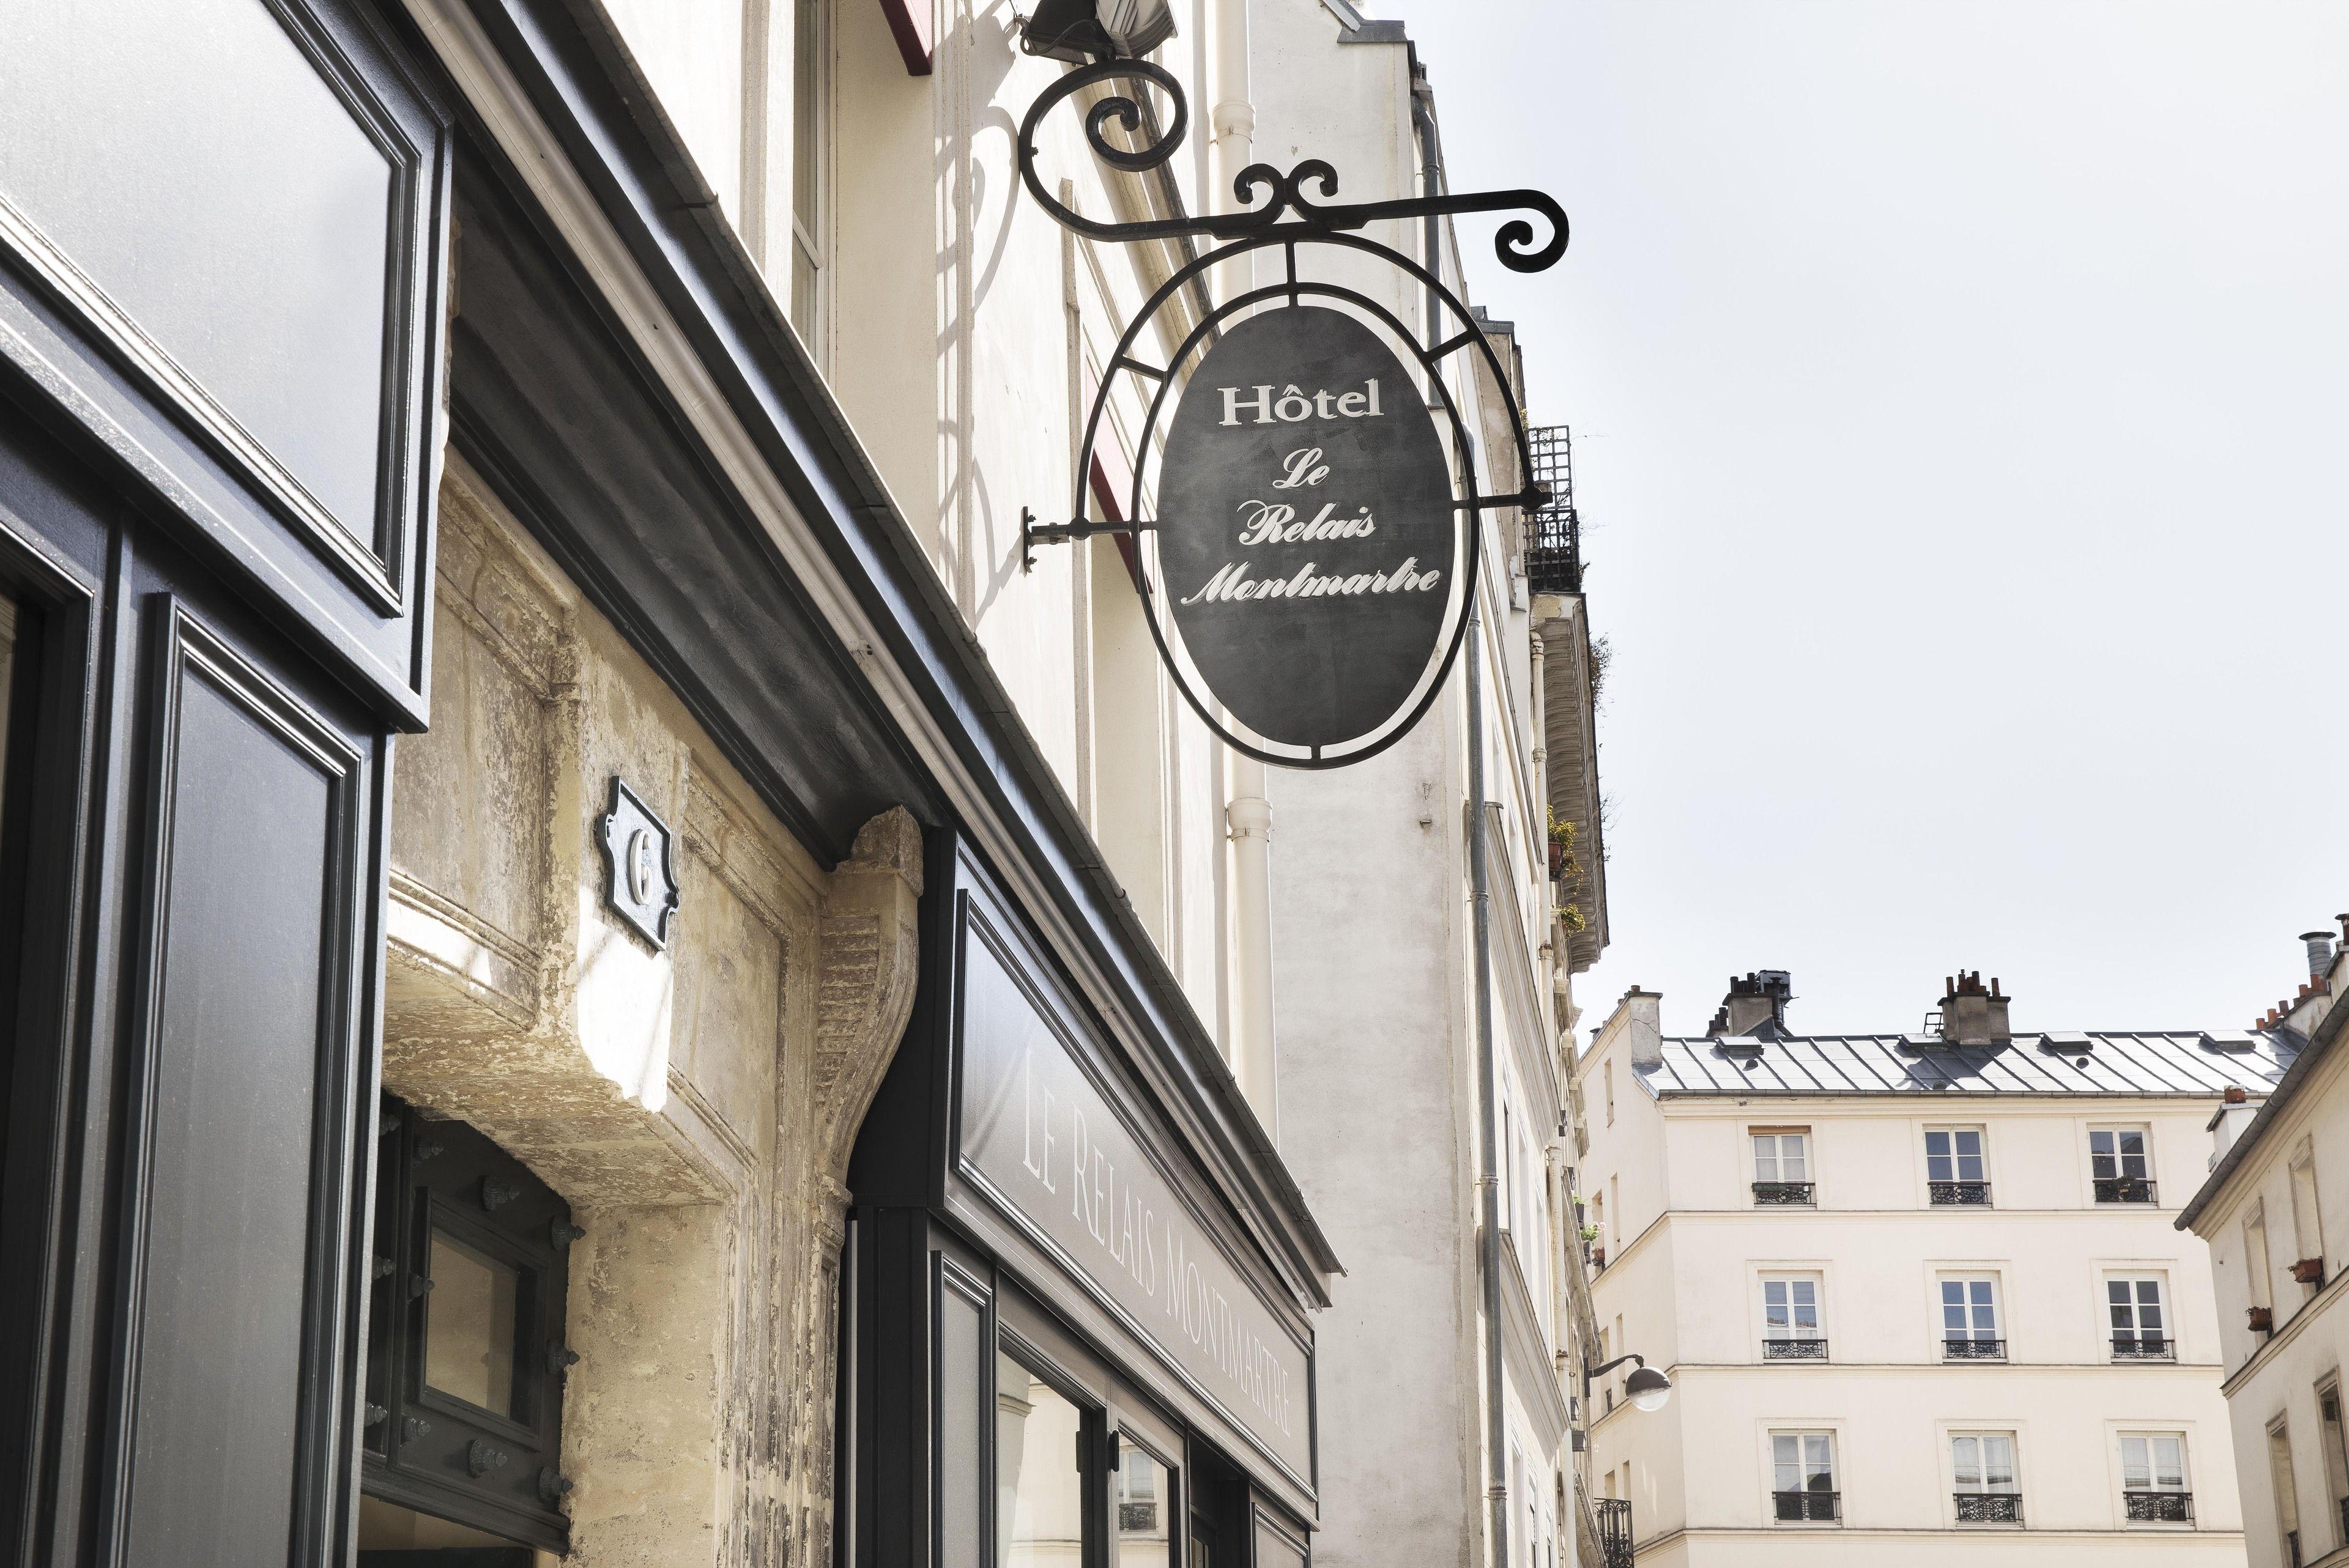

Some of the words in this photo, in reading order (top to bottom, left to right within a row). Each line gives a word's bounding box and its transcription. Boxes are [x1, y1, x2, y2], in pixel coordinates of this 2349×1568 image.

[1217, 379, 1384, 426] Hôtel
[1272, 447, 1330, 489] Le
[1237, 500, 1376, 545] Relais
[1181, 557, 1441, 605] Montmartre
[1022, 1047, 1056, 1196] LE
[1071, 1101, 1156, 1298] RELAIS
[1165, 1222, 1291, 1439] MONTMARTRE
